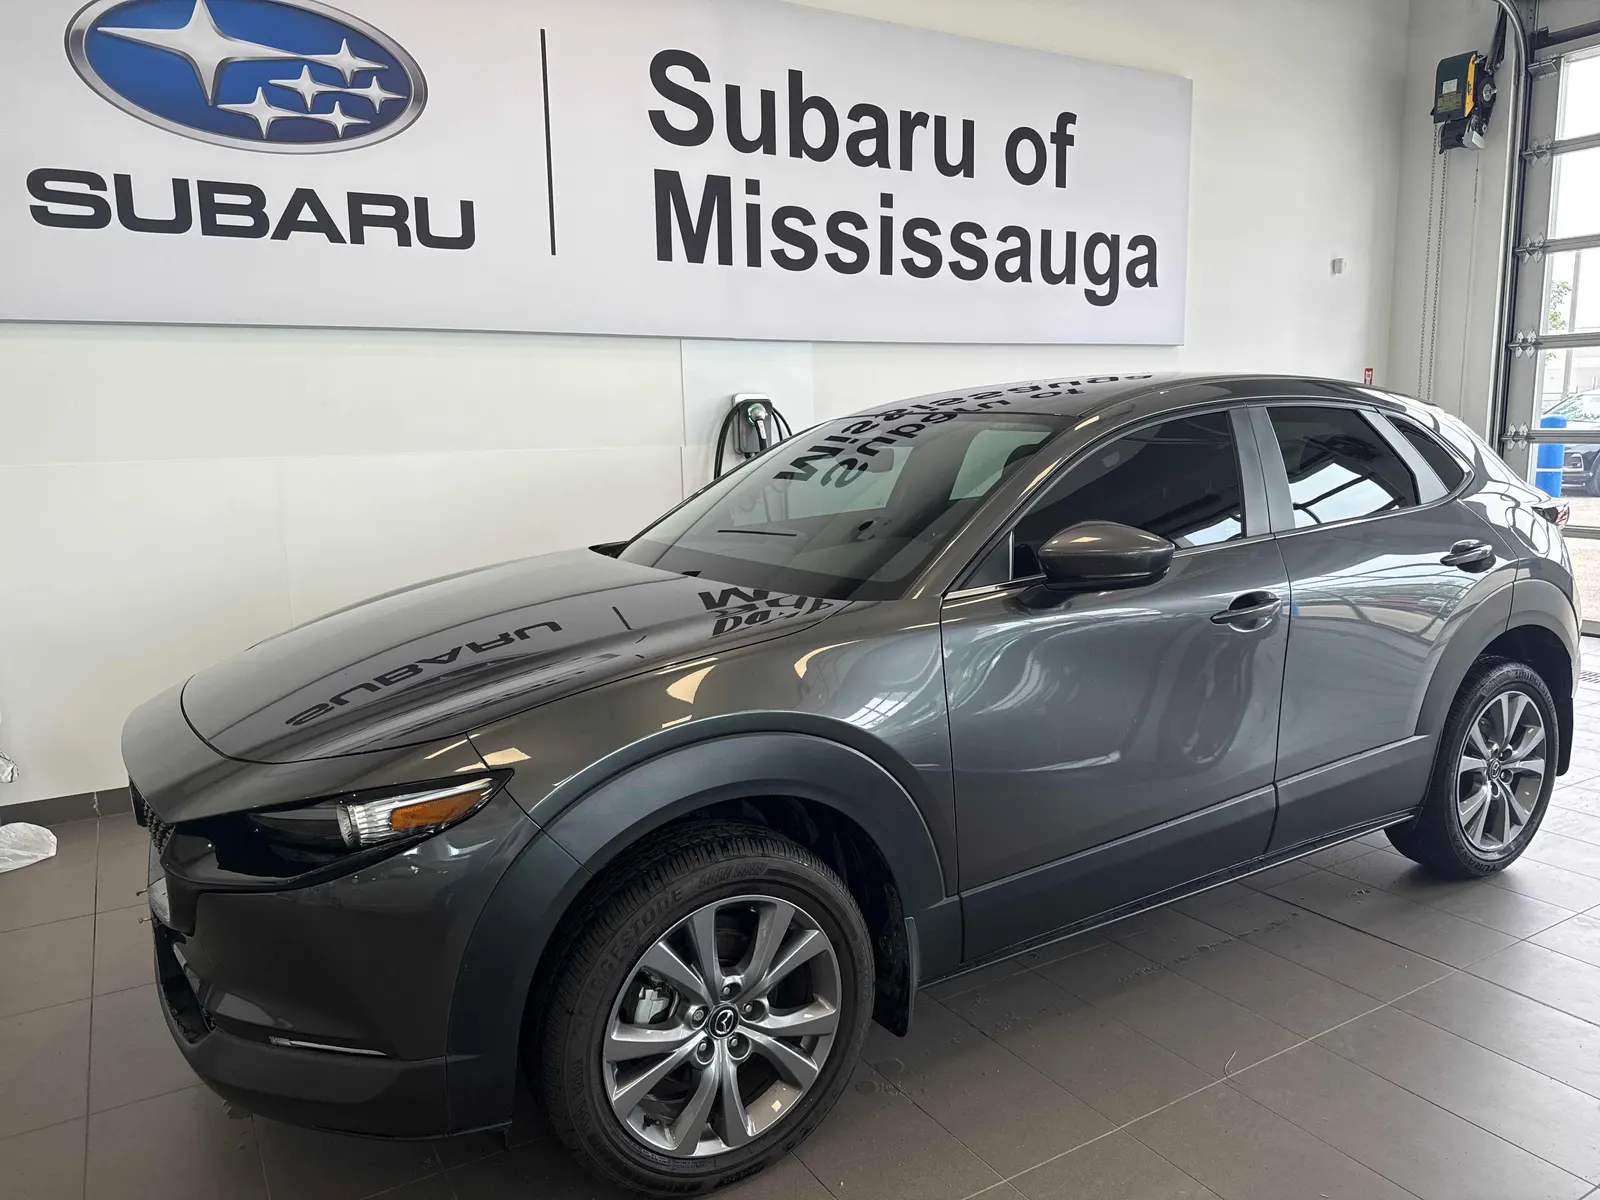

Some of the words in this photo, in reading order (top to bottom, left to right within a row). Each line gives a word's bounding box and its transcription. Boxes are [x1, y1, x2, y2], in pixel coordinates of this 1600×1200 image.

[648, 50, 975, 179] Subaru
[1005, 111, 1078, 189] of
[27, 167, 475, 250] SUBARU
[653, 168, 1159, 307] Mississauga
